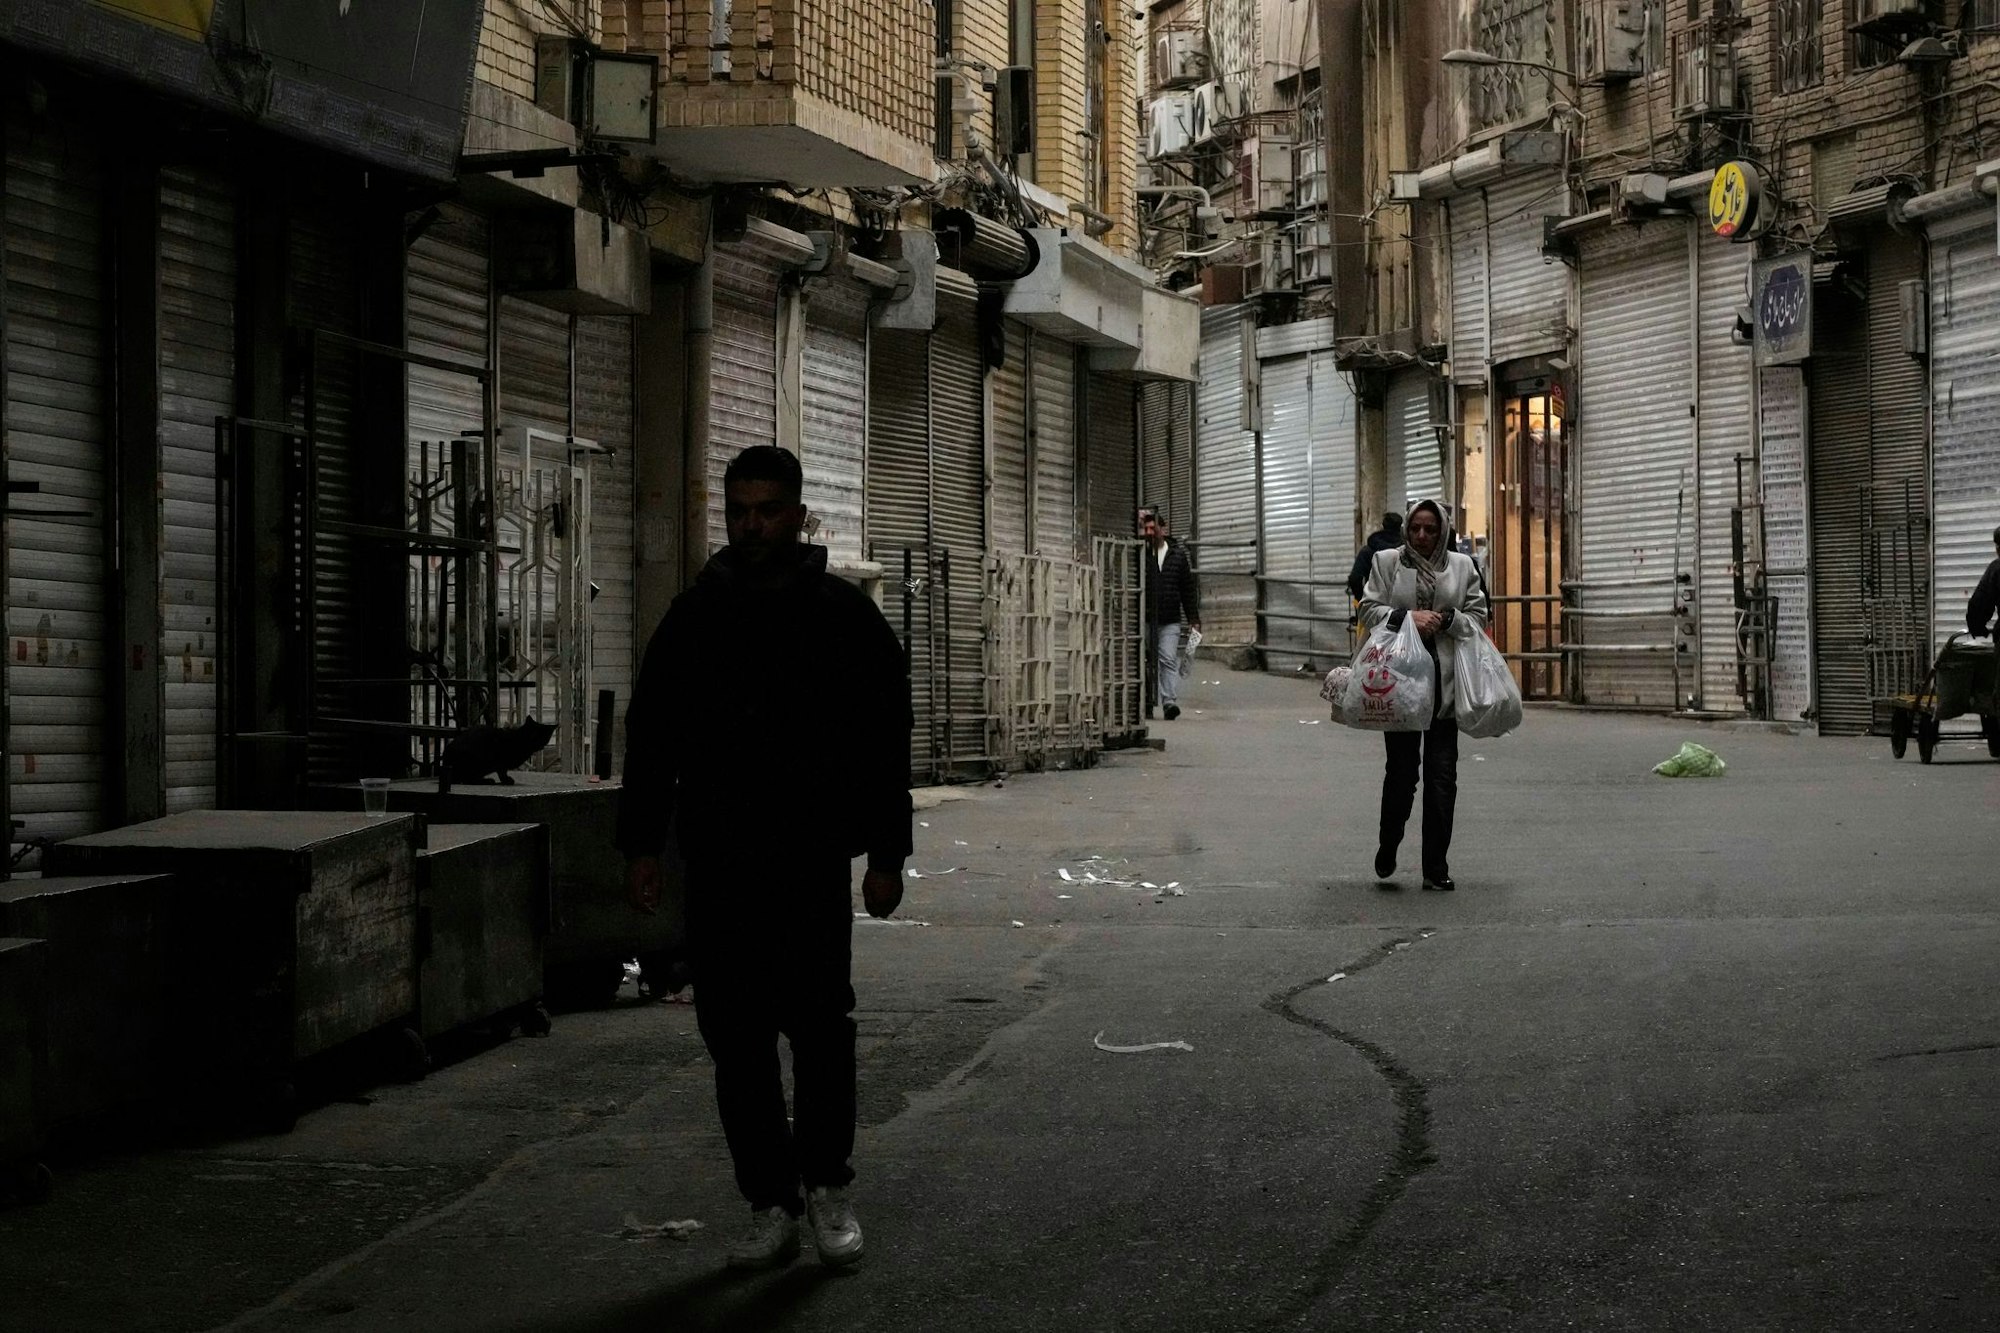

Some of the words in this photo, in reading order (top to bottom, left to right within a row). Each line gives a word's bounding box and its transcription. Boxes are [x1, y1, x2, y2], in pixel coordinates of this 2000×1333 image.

[1777, 288, 1791, 329] حاج
[1789, 285, 1806, 325] سرای
[1362, 698, 1395, 711] SMILE
